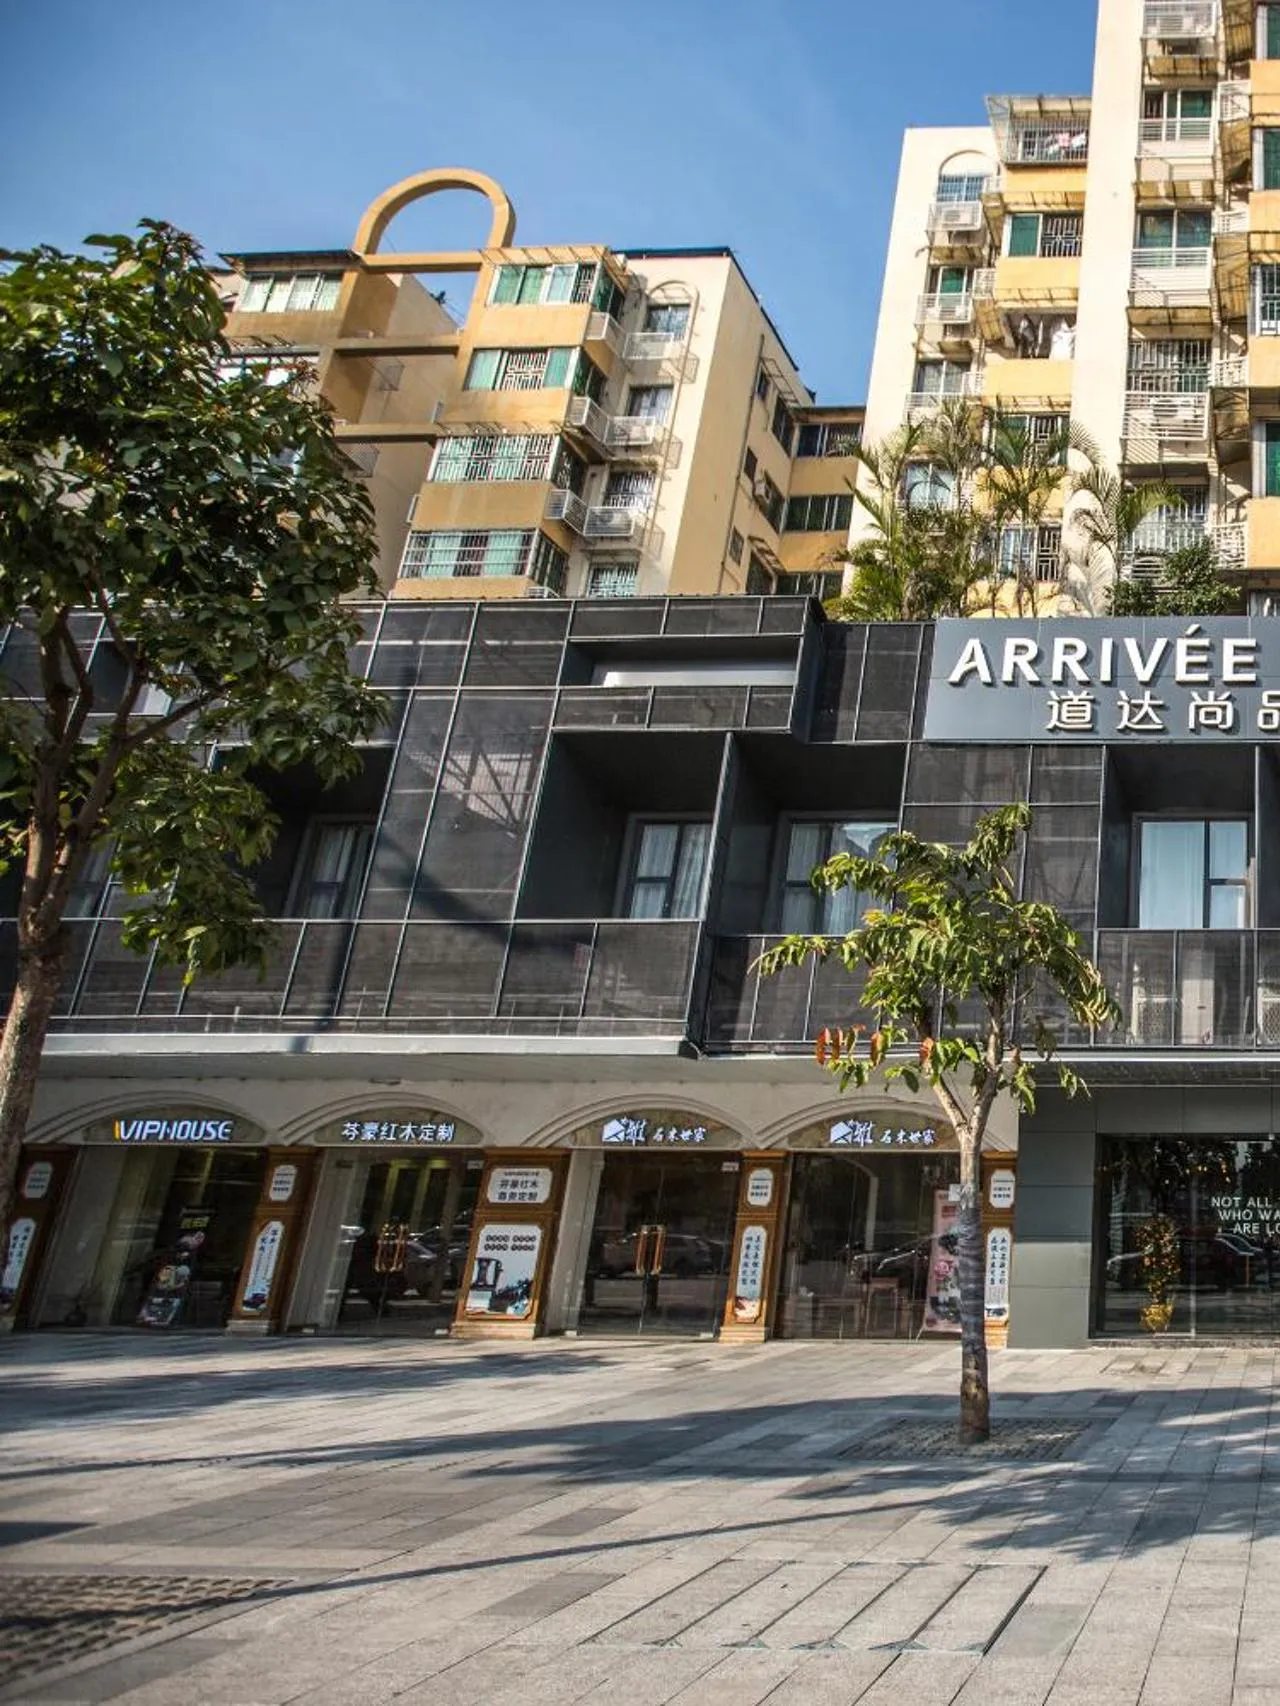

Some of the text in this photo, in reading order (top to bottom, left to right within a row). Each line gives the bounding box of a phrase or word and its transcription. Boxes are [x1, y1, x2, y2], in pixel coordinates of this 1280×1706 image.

[949, 624, 1257, 684] ARRIVÉE
[1211, 1196, 1242, 1208] NOT
[1246, 1196, 1273, 1208] ALL
[1218, 1208, 1253, 1221] WHO
[1233, 1222, 1260, 1234] ARE
